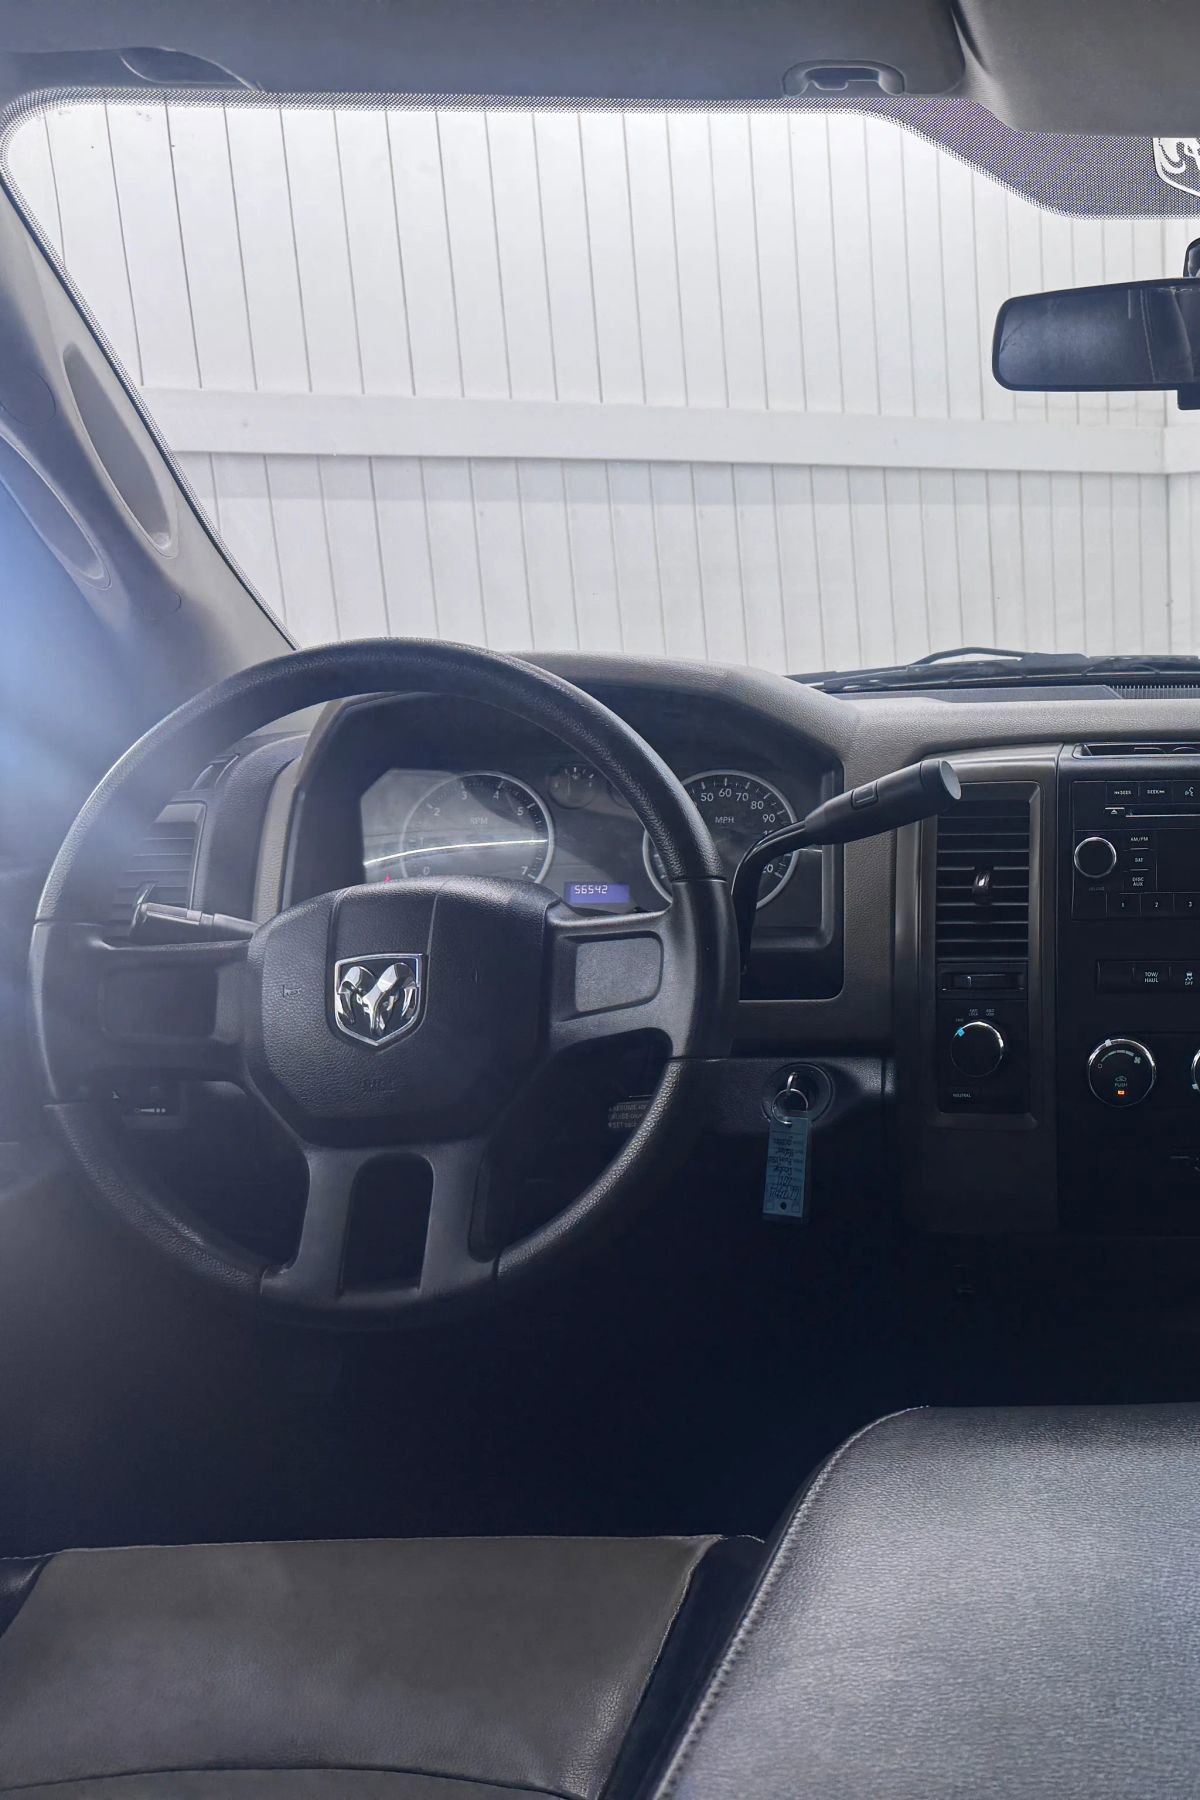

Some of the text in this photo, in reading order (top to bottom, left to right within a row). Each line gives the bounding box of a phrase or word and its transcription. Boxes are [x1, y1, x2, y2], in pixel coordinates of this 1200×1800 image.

[460, 791, 469, 800] 3
[492, 790, 501, 800] 4
[699, 792, 715, 802] 50
[717, 788, 733, 798] 60
[734, 792, 750, 802] 70
[749, 799, 765, 810] 80
[433, 807, 442, 817] 2
[516, 806, 525, 816] 5
[469, 816, 489, 826] RPM
[714, 815, 736, 824] MPH
[761, 813, 776, 823] 90
[422, 866, 431, 876] 0
[520, 866, 529, 876] 7
[574, 884, 608, 896] 56542
